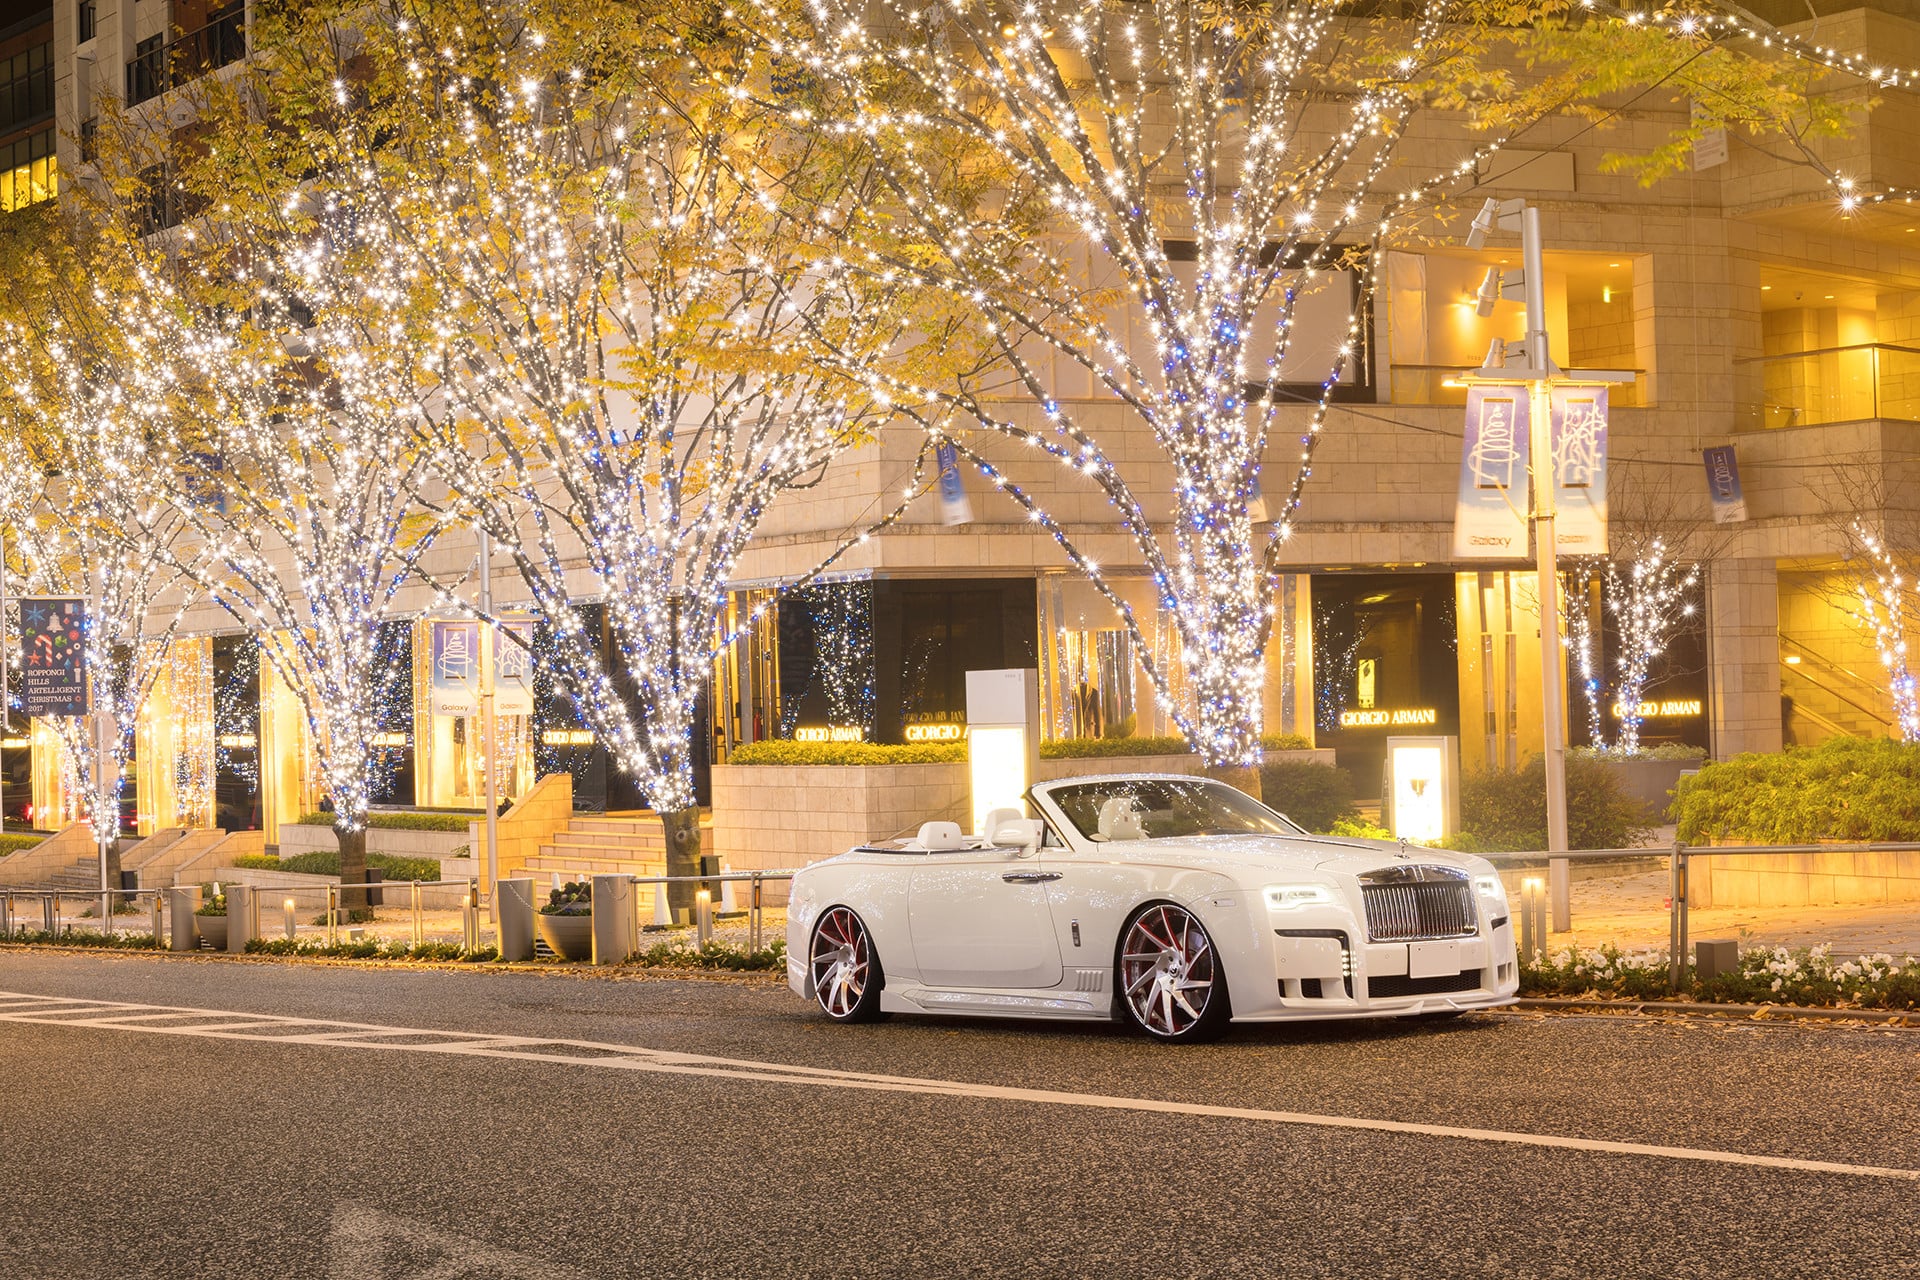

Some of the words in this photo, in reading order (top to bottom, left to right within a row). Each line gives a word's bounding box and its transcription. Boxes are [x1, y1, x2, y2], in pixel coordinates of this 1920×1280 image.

[1469, 535, 1512, 548] Galaxy
[27, 669, 65, 677] ROPPONGI
[27, 695, 73, 704] CHRISTMAS
[28, 705, 44, 713] 2017
[441, 704, 469, 712] Galaxy
[1660, 701, 1701, 715] ARMANI
[1340, 711, 1389, 726] GIORGIO
[1391, 709, 1436, 724] ARMANI
[795, 727, 829, 742] GIORGIO
[830, 727, 862, 742] ARMANI
[905, 725, 961, 741] GIORGIO
